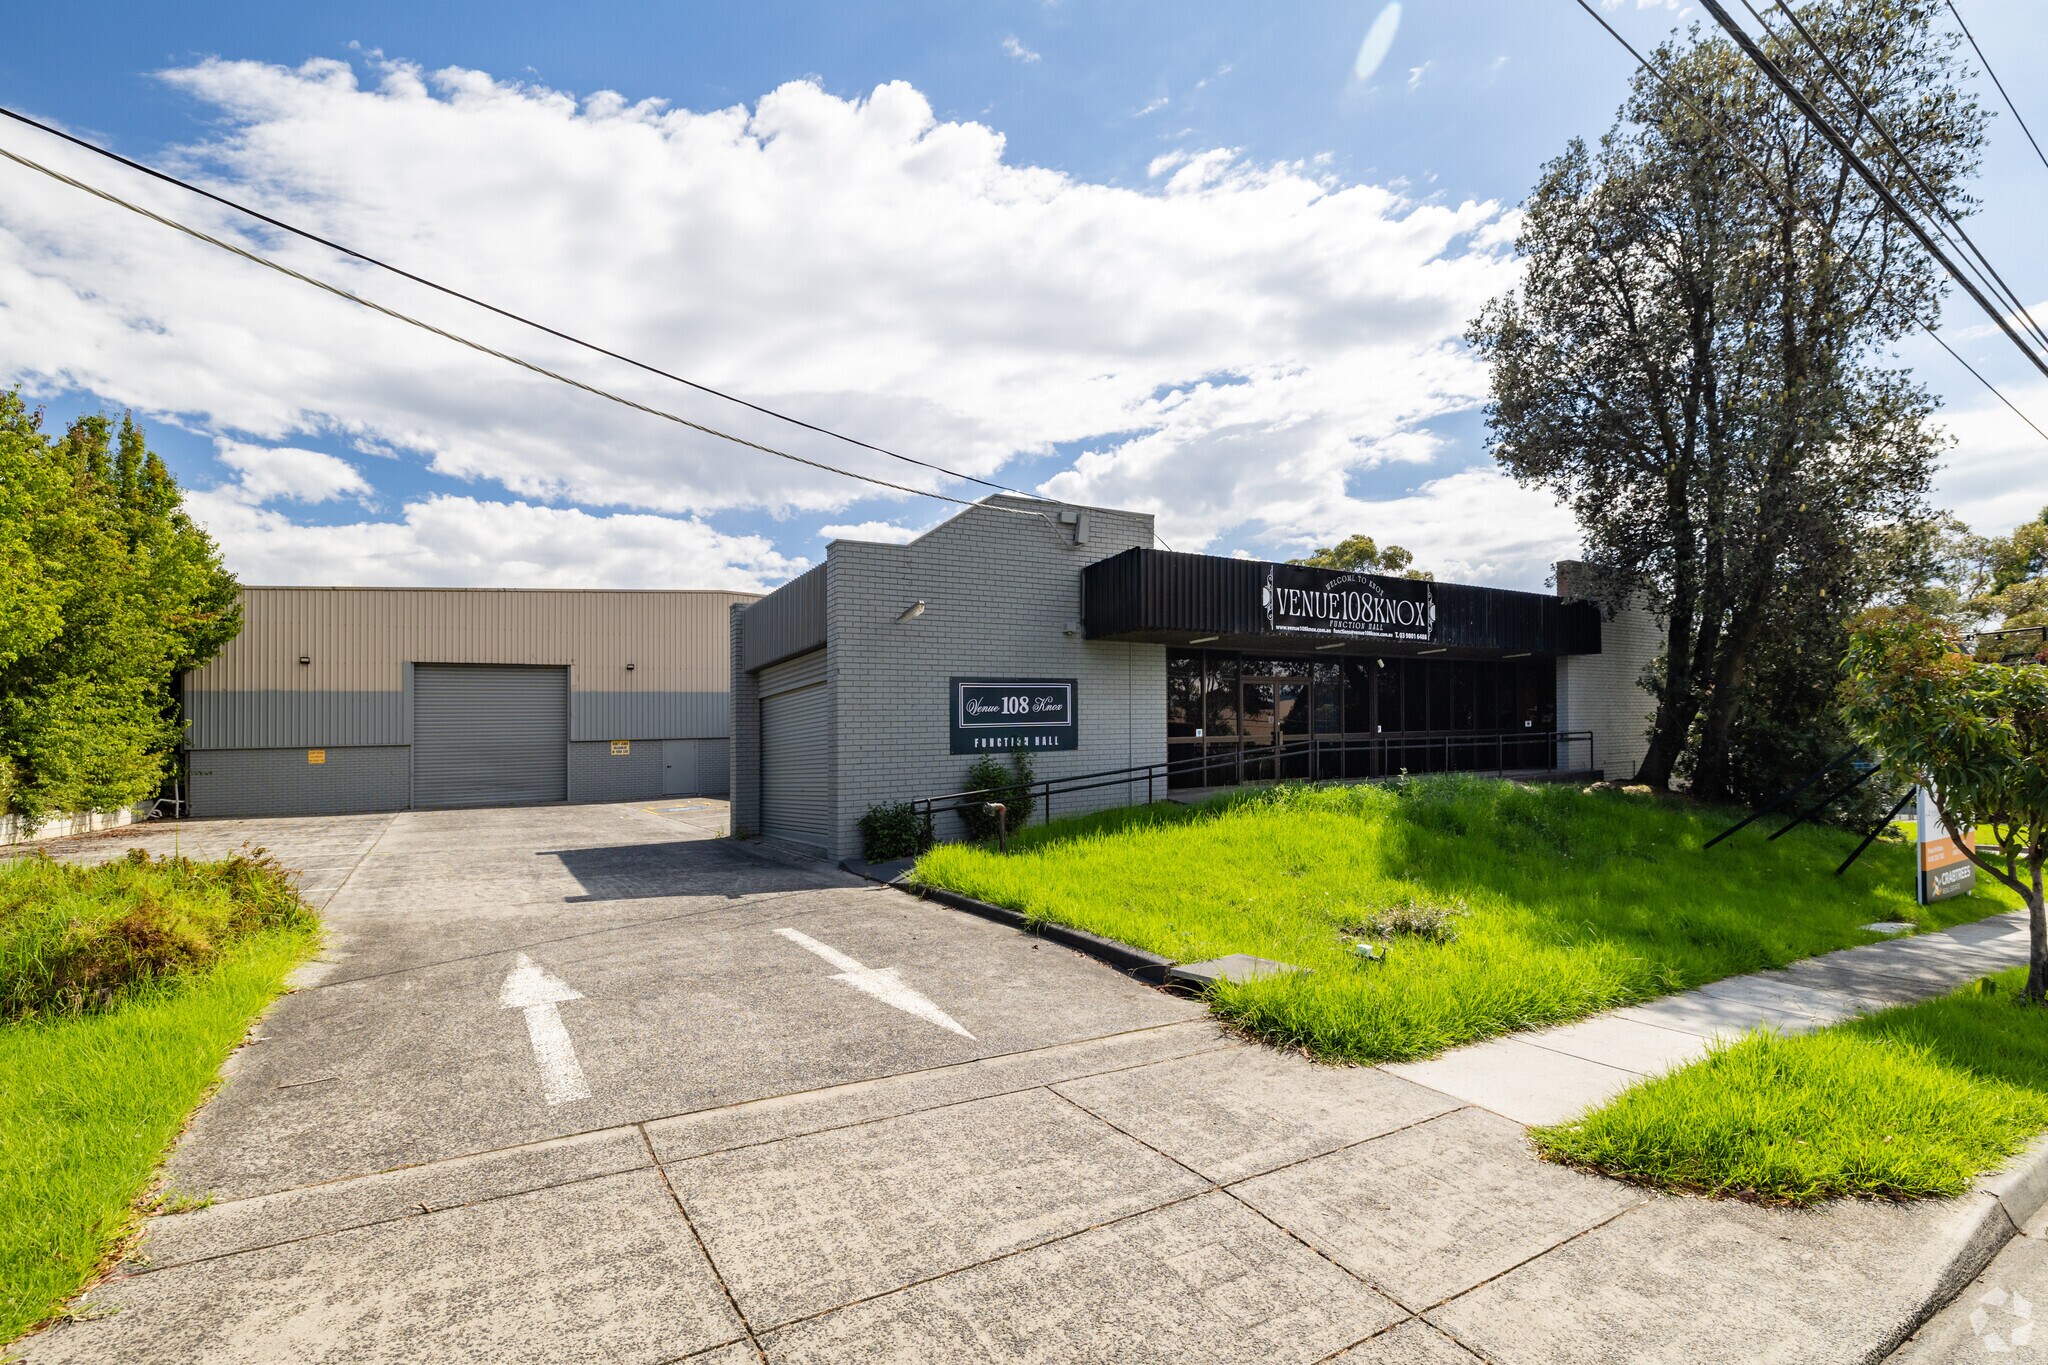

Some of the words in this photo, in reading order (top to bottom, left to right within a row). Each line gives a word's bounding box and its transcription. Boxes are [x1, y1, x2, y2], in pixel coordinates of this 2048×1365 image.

[1325, 575, 1355, 590] WELCOME
[1358, 576, 1367, 584] TO
[1368, 581, 1384, 596] KNOX
[1276, 588, 1425, 626] VENUE108KNOX
[1329, 620, 1365, 630] FUNCTION
[1368, 623, 1383, 631] HALL
[966, 697, 1000, 716] Venue
[1001, 696, 1029, 715] 108
[1032, 696, 1063, 712] Knox
[1035, 736, 1059, 746] HALL
[1941, 865, 1970, 885] CRABTREES
